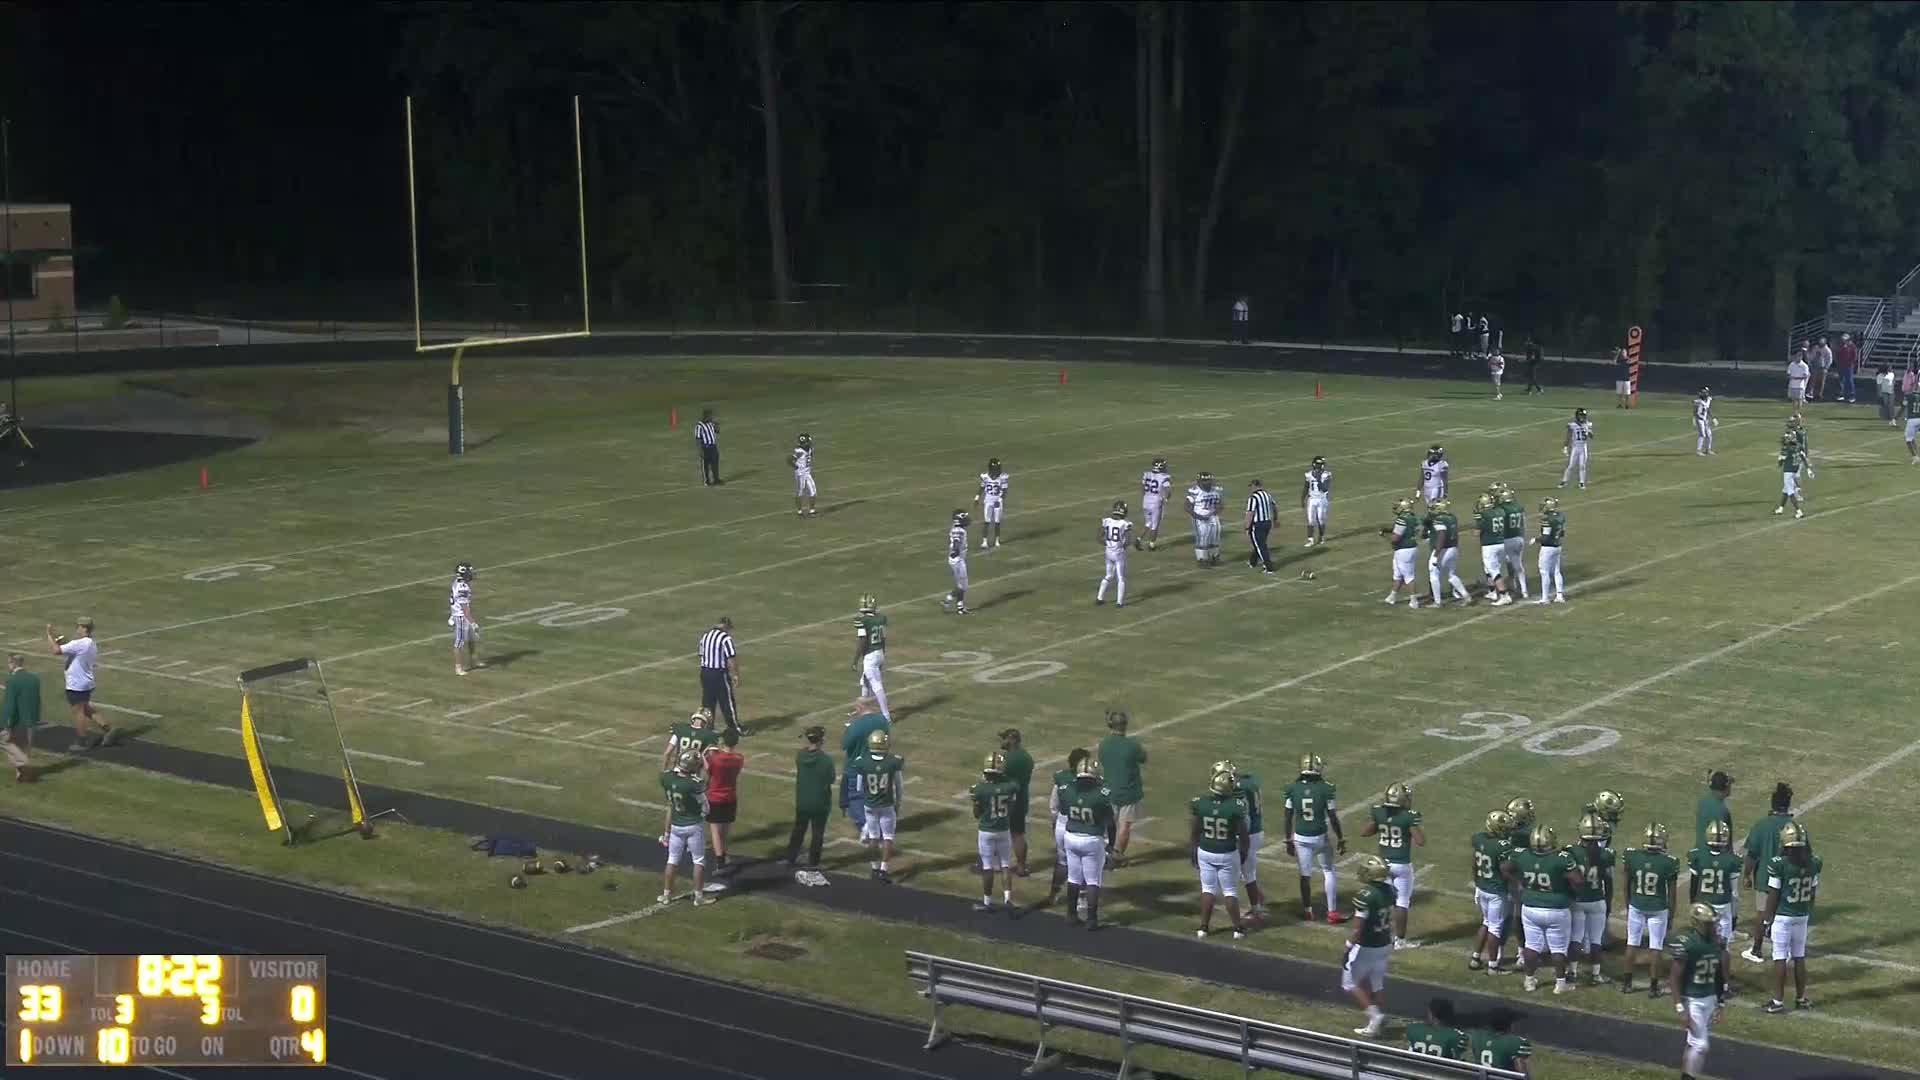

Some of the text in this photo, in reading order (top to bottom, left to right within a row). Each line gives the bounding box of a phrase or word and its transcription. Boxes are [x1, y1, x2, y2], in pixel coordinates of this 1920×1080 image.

[485, 601, 630, 627] 10
[887, 650, 1068, 684] 20
[1423, 711, 1622, 756] 30
[867, 773, 889, 795] 84
[1302, 798, 1314, 821] 5
[1203, 816, 1229, 840] 56
[1636, 869, 1659, 896] 18
[1701, 868, 1724, 894] 21
[1787, 877, 1812, 903] 32
